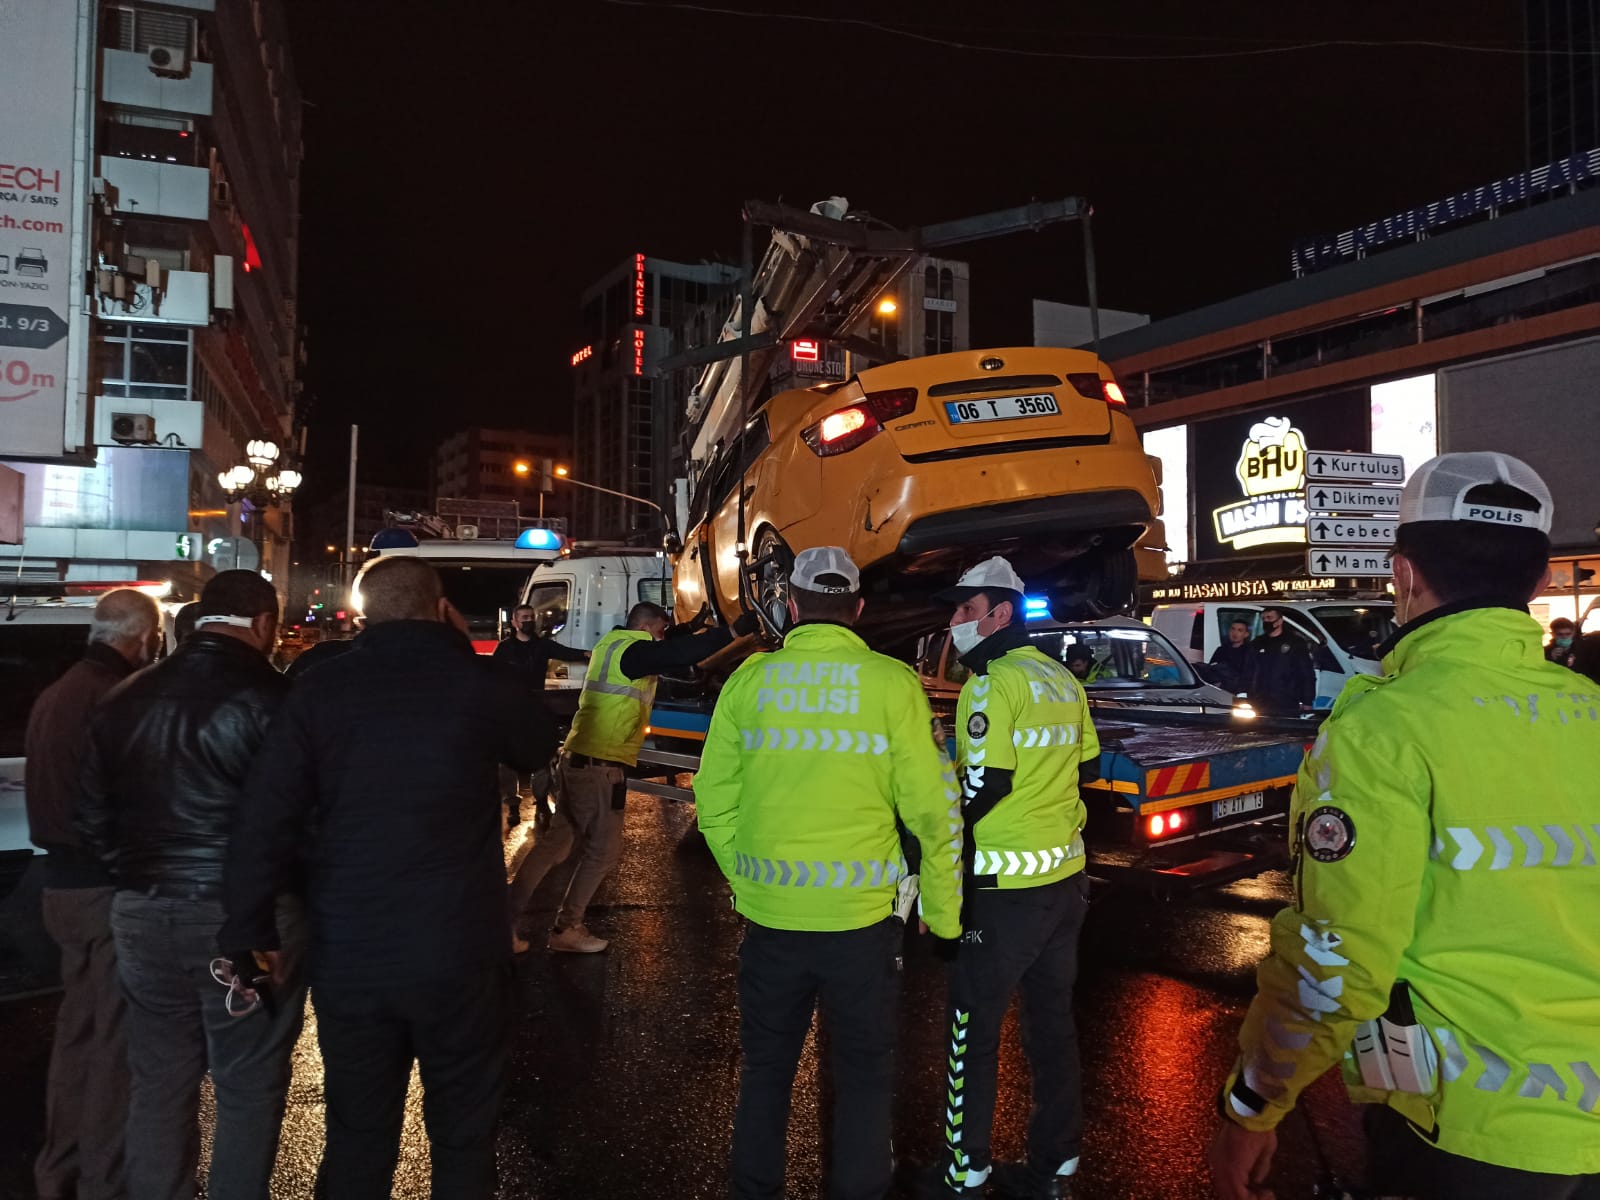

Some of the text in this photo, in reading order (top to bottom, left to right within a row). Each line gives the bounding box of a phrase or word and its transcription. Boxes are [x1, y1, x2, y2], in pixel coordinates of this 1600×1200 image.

[0, 164, 60, 193] ECH
[0, 316, 50, 332] d. 9/3
[634, 328, 645, 376] HOTEL
[0, 359, 55, 388] 0m
[826, 361, 849, 376] STO
[957, 402, 980, 420] 06
[987, 400, 999, 417] T
[1014, 395, 1055, 415] 3560
[1248, 446, 1298, 479] BHU
[1331, 457, 1399, 476] Kurtuluş
[1333, 490, 1400, 506] Dikimevi
[1221, 499, 1309, 535] HASAN US
[1469, 507, 1523, 523] POLİS
[1335, 554, 1391, 569] Mama
[1184, 582, 1229, 599] HASAN
[1232, 579, 1269, 597] USTA
[764, 661, 863, 687] TRAFİK
[757, 688, 861, 714] POLİSİ
